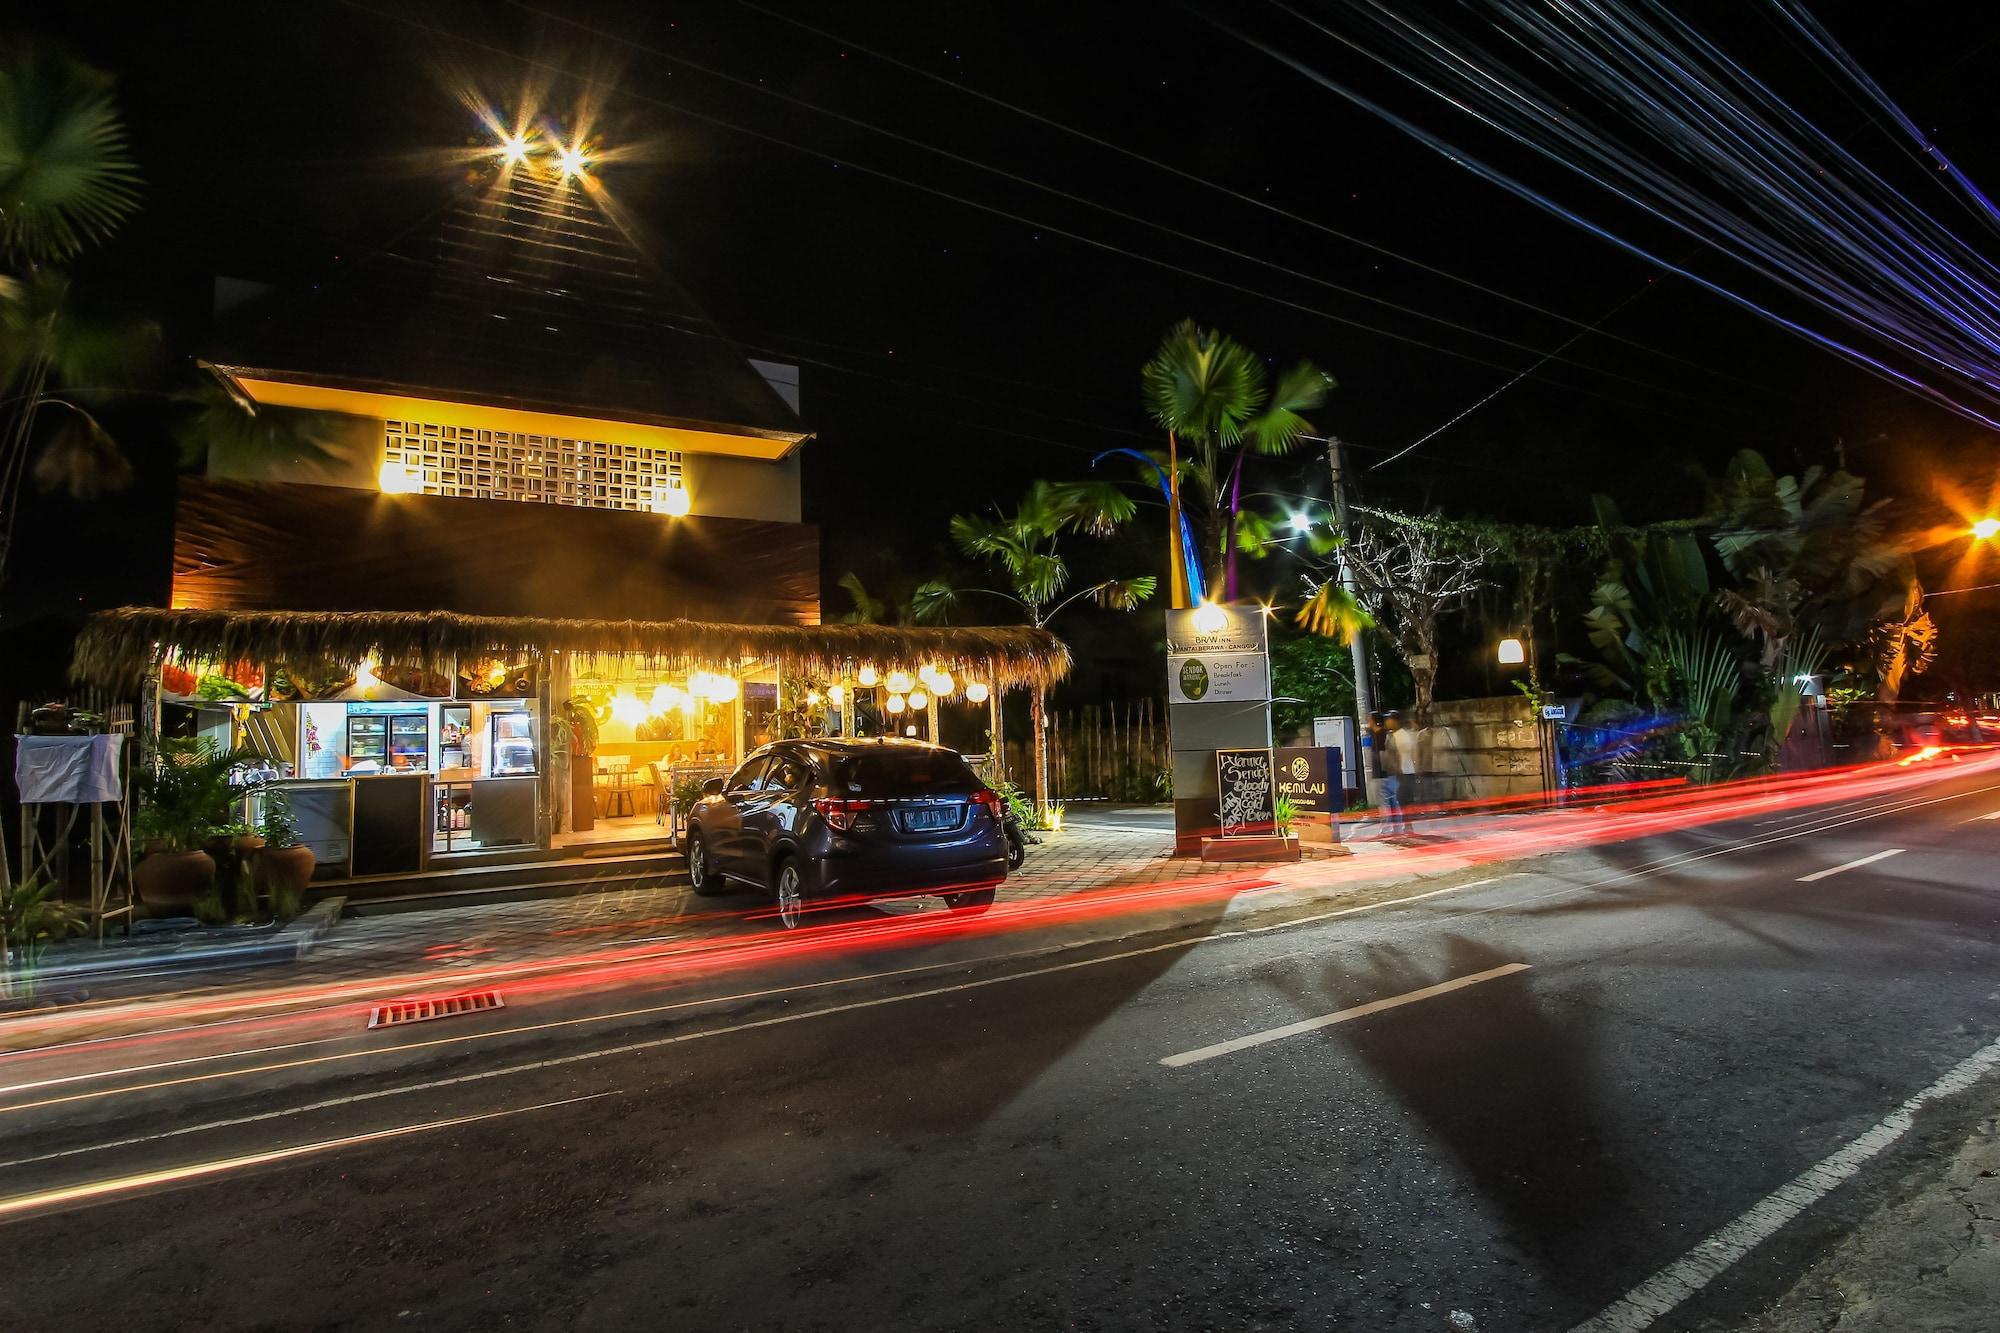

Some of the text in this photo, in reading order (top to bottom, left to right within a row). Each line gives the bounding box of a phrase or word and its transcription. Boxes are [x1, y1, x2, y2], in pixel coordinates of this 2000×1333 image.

[1213, 663, 1232, 671] Open
[1236, 661, 1248, 669] For
[1278, 782, 1325, 795] KEMILAU
